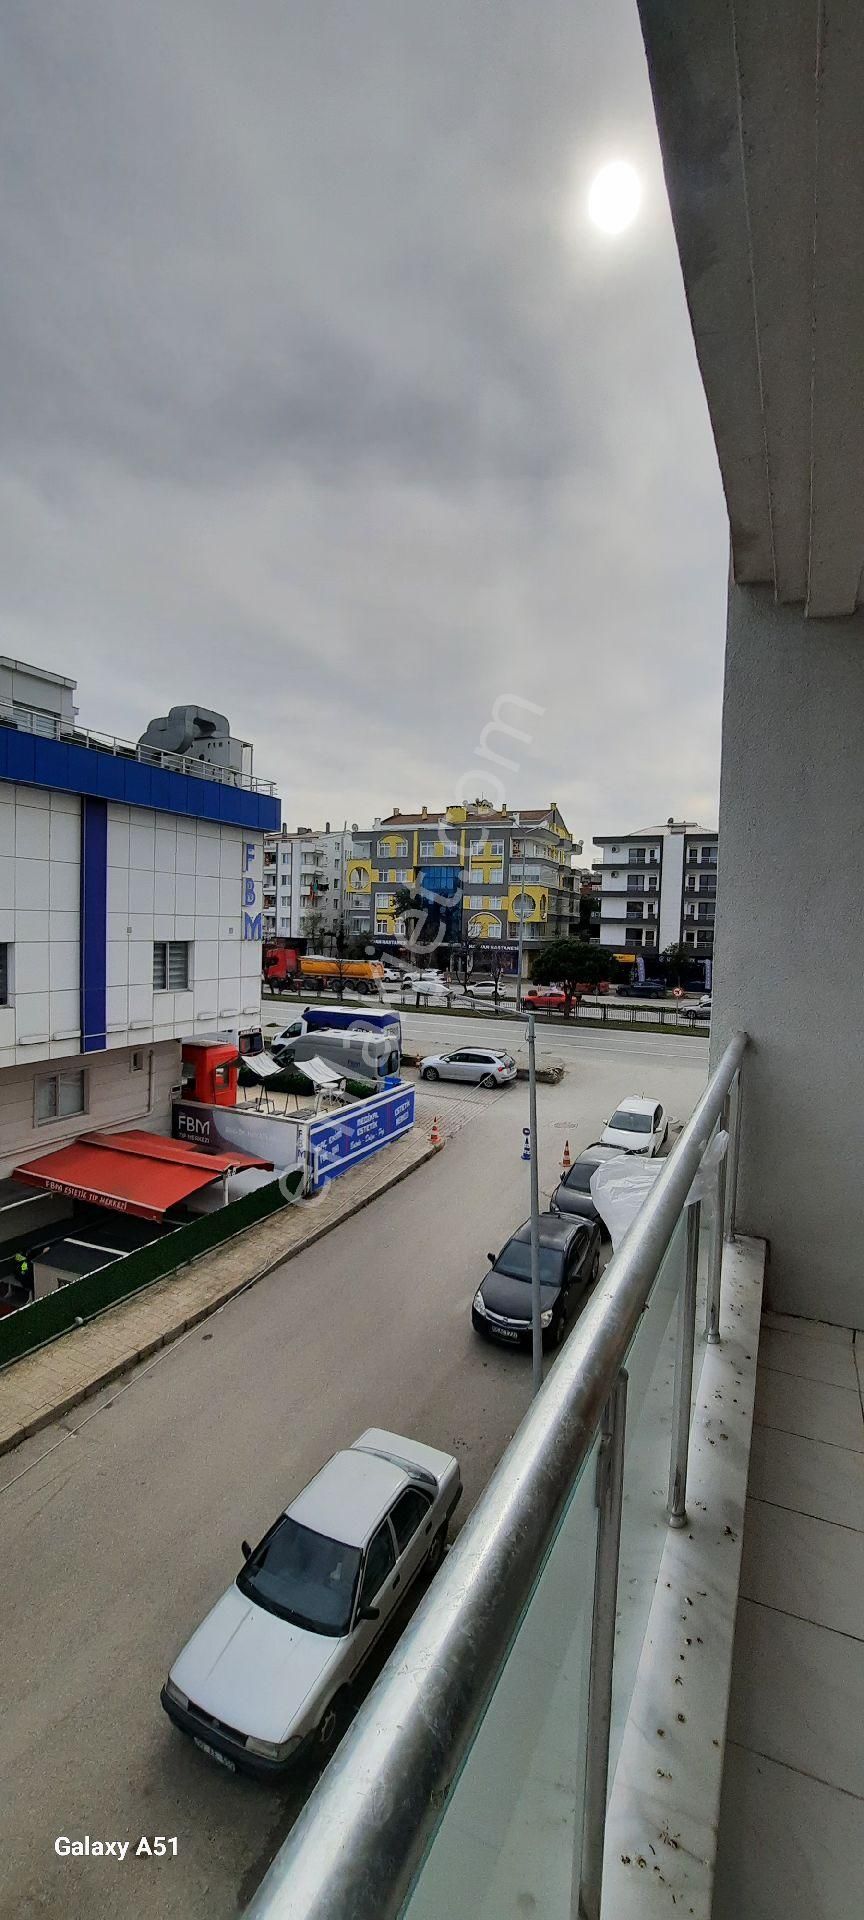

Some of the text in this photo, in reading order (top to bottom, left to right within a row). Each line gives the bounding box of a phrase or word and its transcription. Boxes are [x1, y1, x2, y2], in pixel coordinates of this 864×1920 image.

[243, 843, 263, 941] FBM
[178, 1115, 210, 1135] FBM
[45, 1180, 62, 1192] FBM
